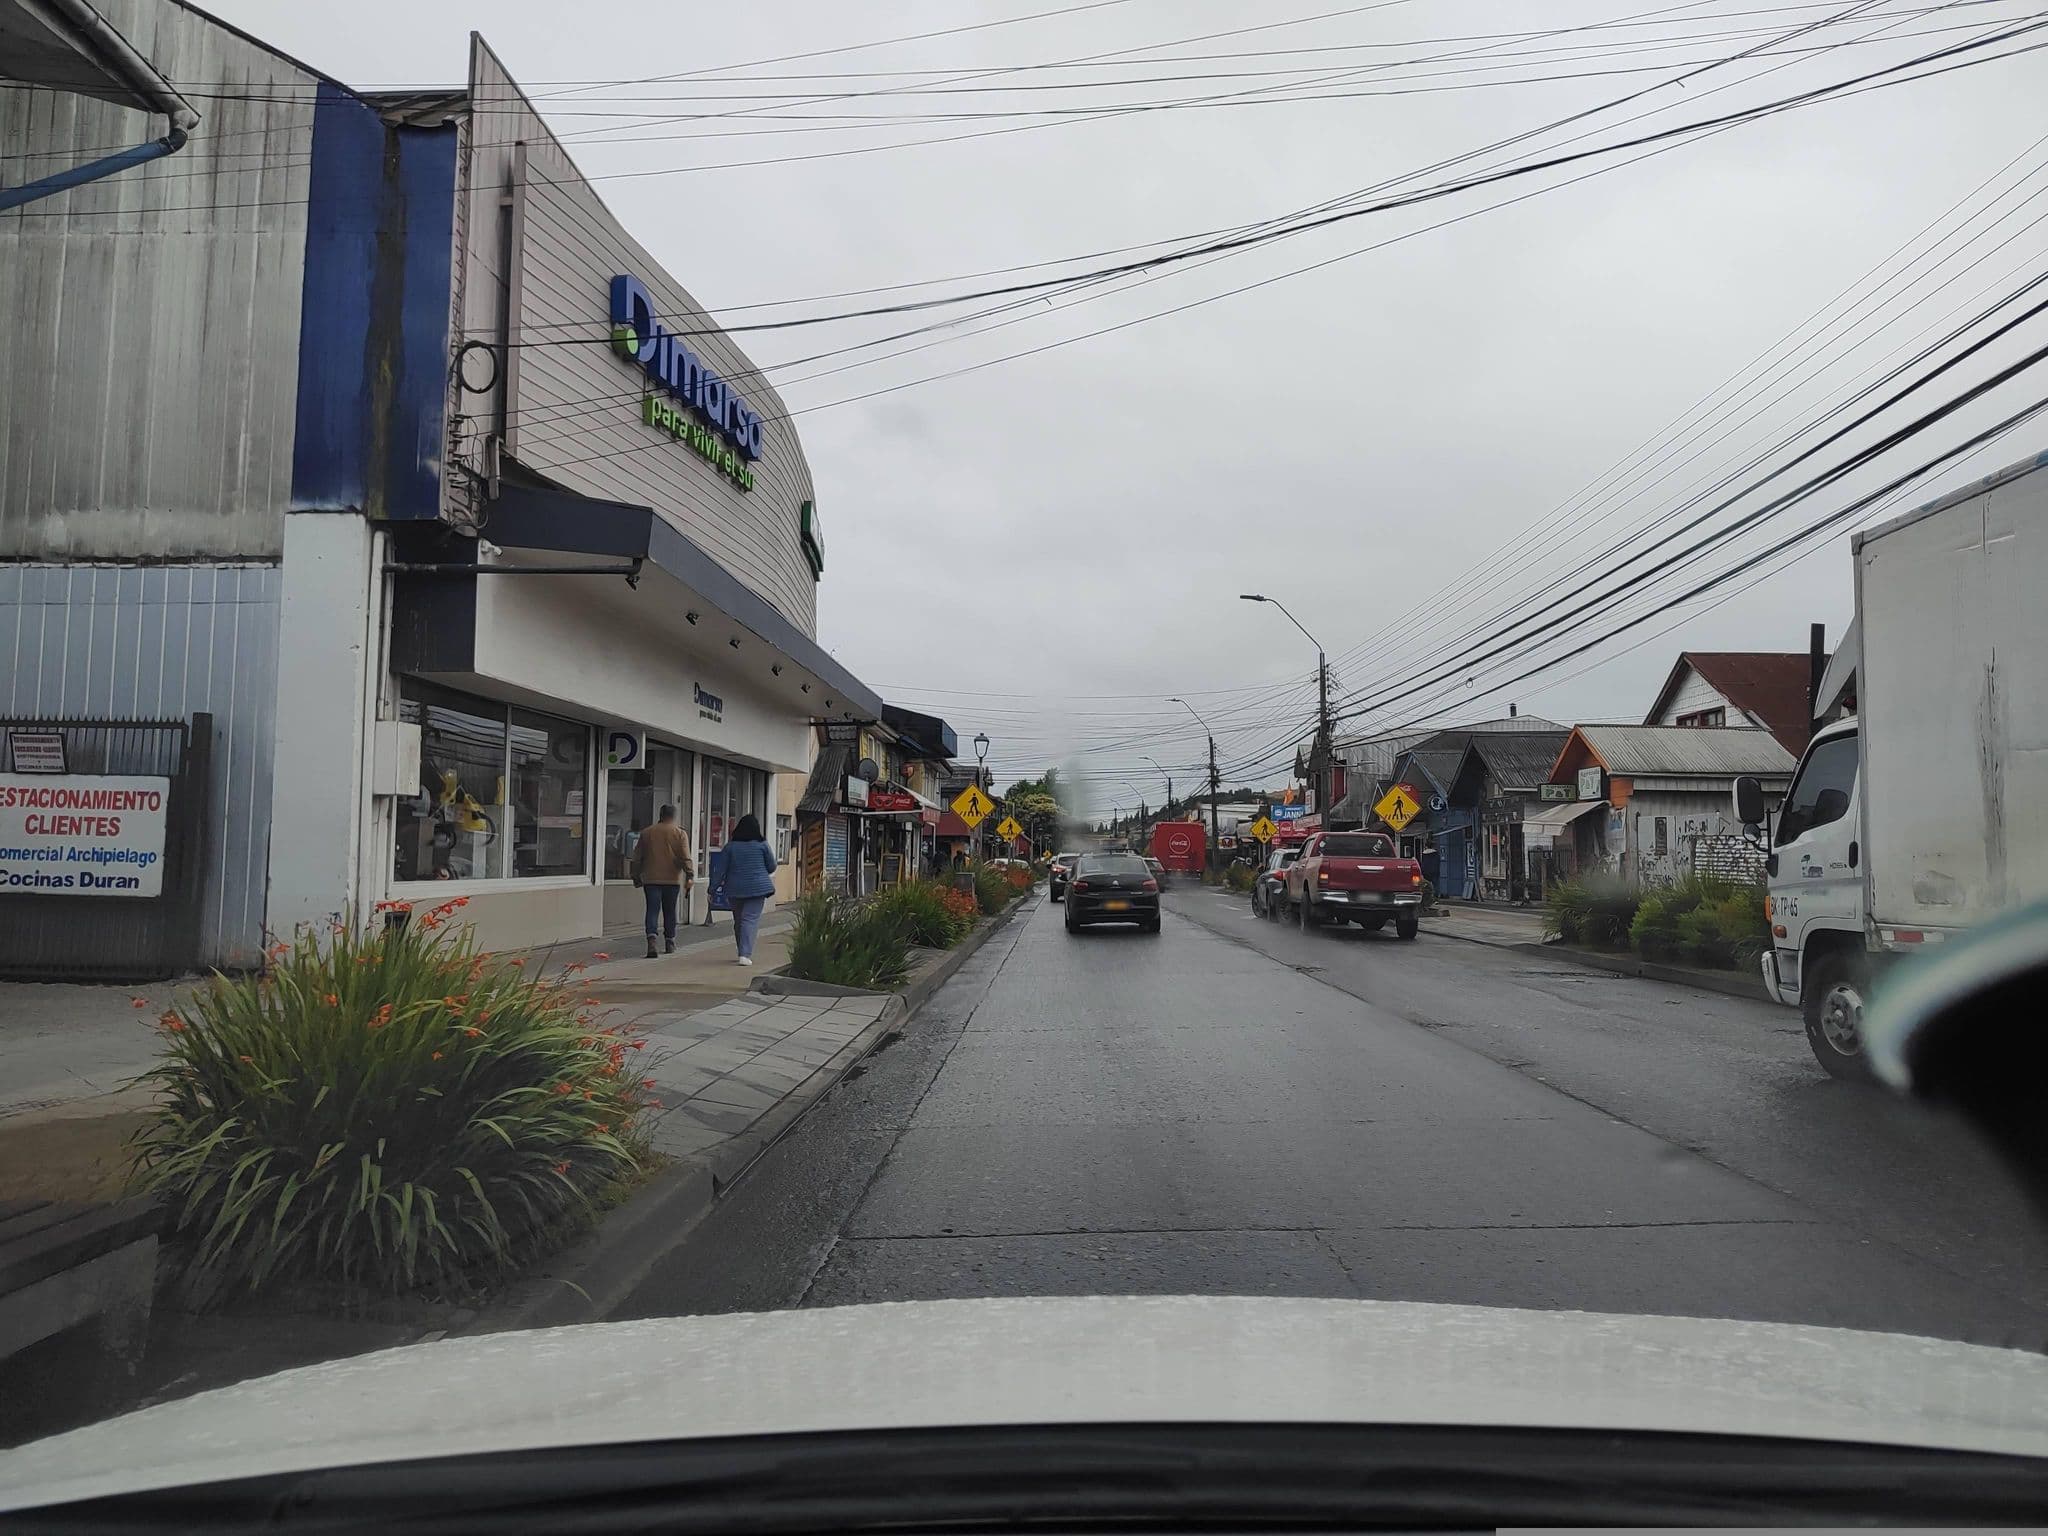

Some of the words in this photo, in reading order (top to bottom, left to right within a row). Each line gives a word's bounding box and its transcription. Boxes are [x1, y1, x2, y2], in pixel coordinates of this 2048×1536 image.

[646, 396, 689, 439] para
[693, 425, 721, 464] vivir
[25, 814, 121, 837] CLIENTES
[0, 846, 63, 862] omercial
[66, 847, 157, 868] Archipielago
[0, 870, 74, 888] Cocinas
[80, 871, 140, 889] Duran
